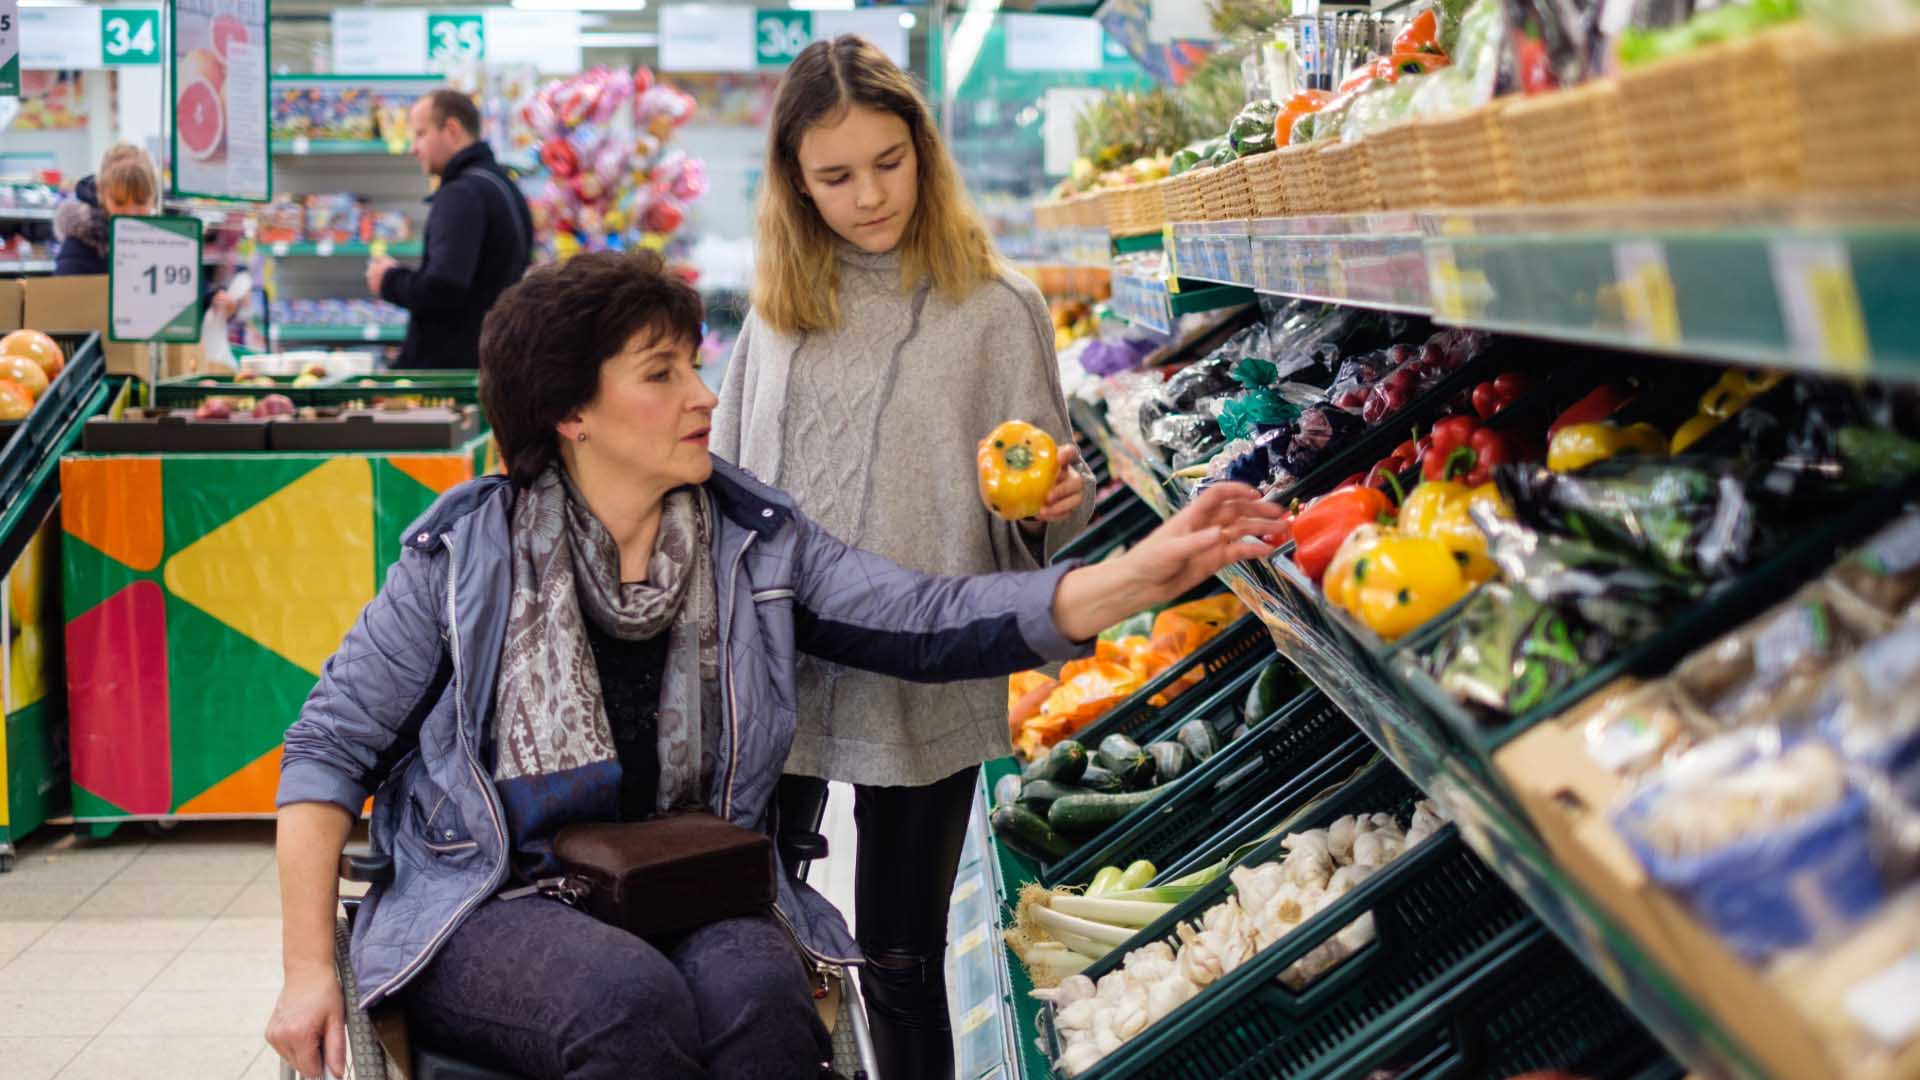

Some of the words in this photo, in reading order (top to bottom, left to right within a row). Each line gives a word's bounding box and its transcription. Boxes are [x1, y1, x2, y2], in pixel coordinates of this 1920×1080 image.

[106, 17, 155, 55] 34
[433, 21, 482, 60] 35
[760, 17, 806, 57] 36
